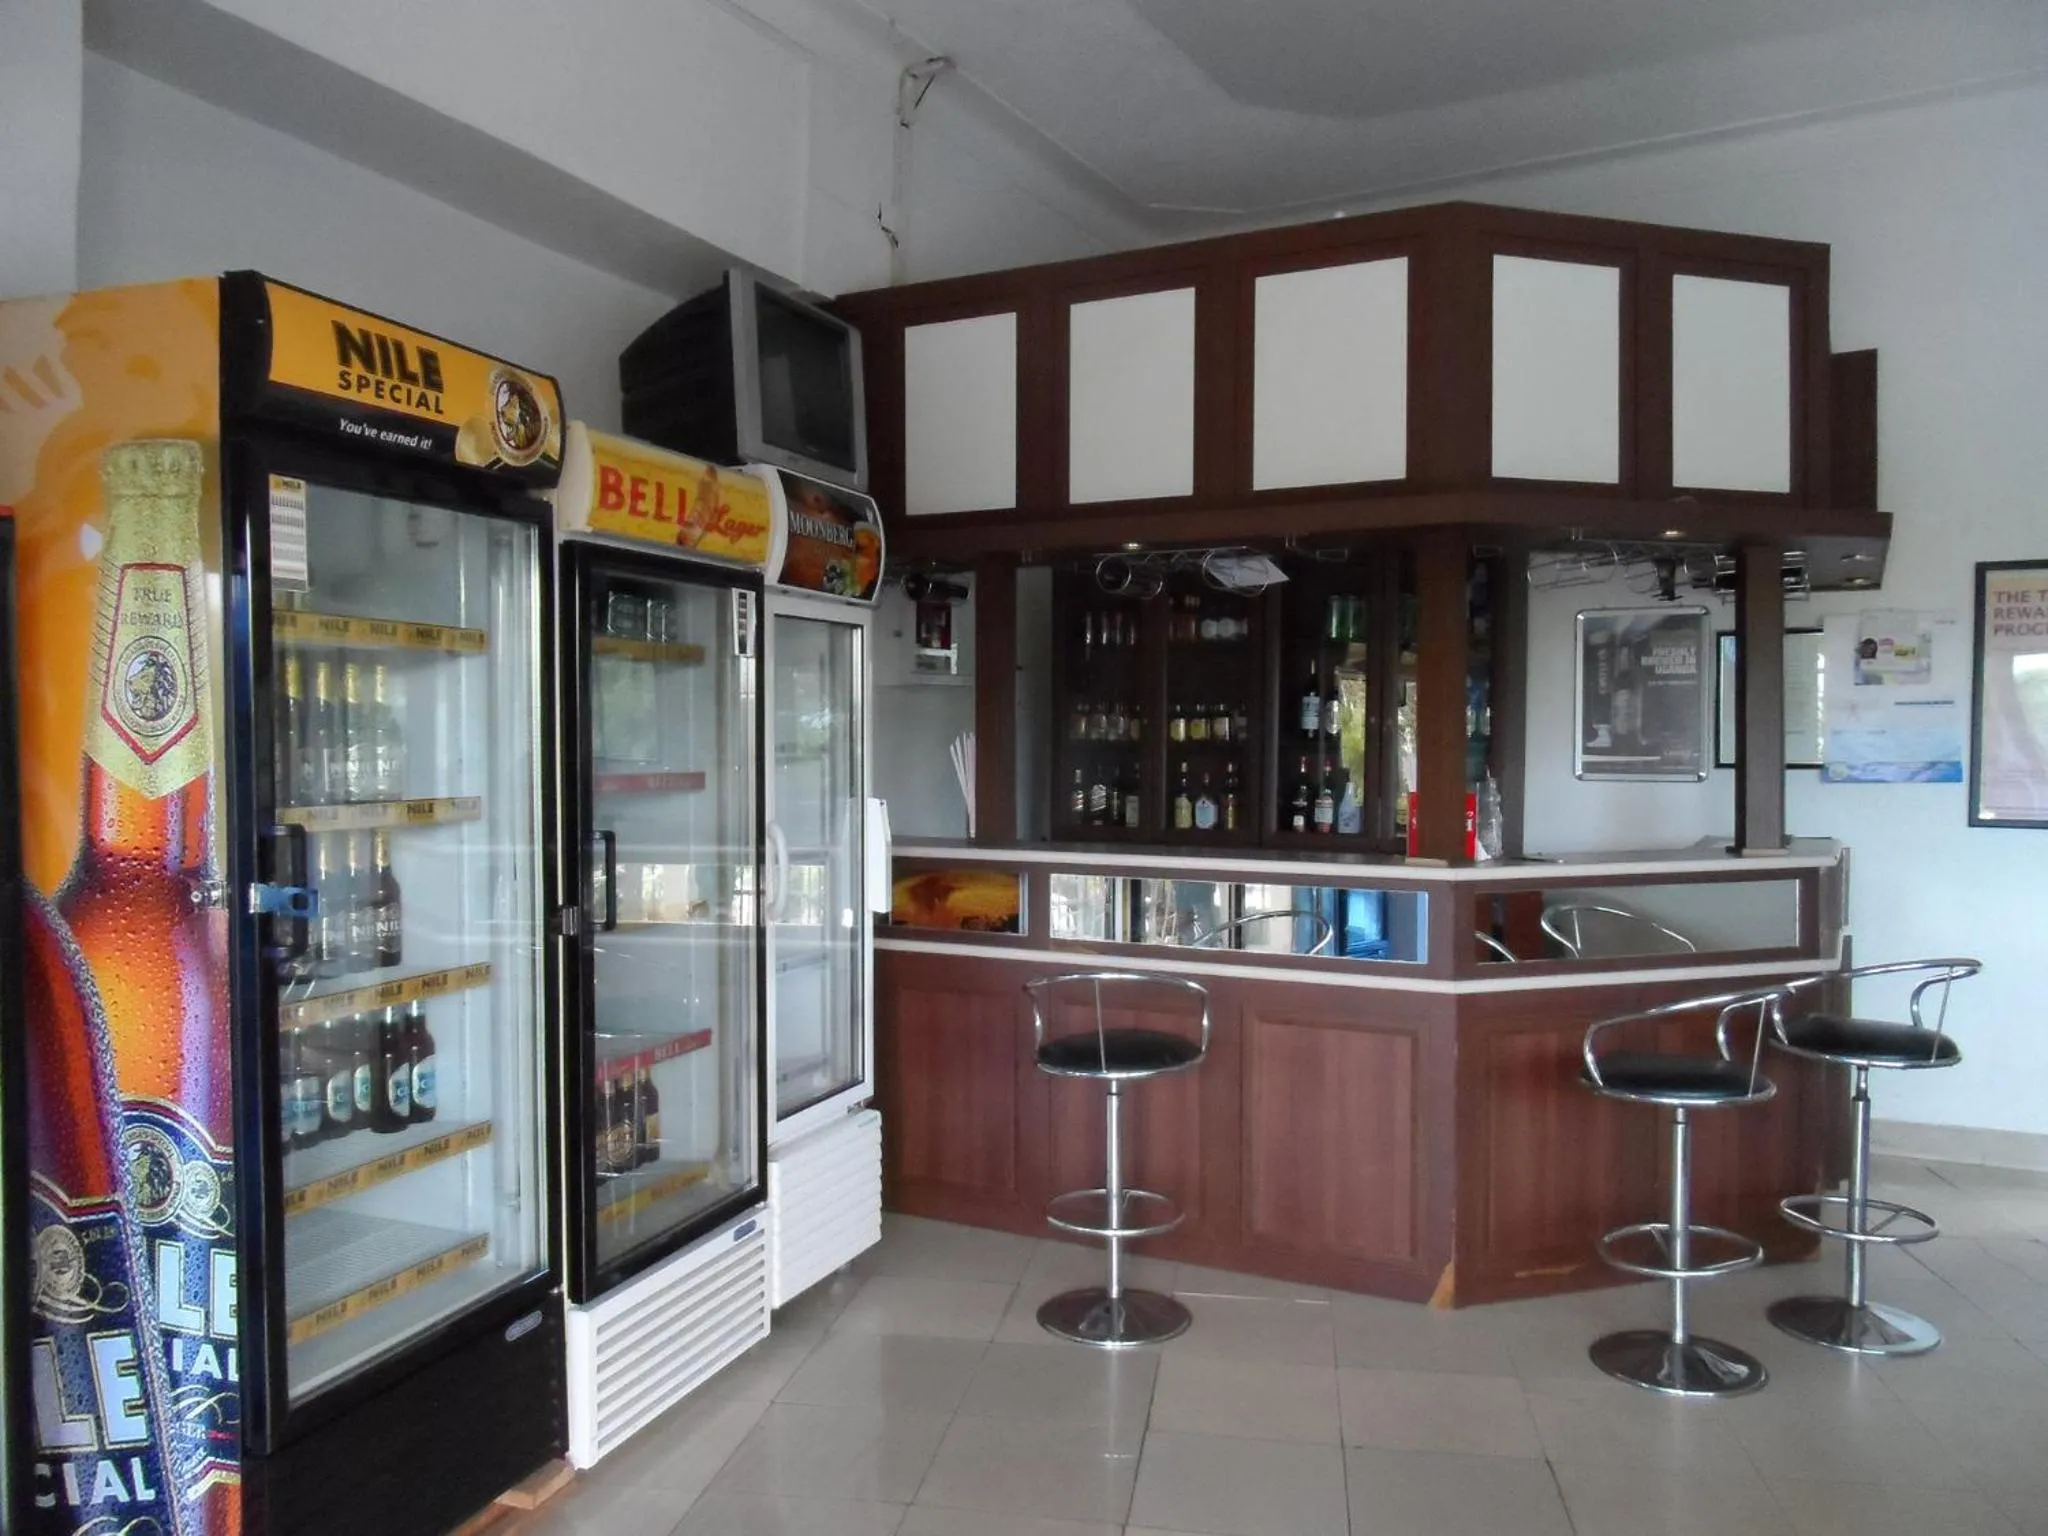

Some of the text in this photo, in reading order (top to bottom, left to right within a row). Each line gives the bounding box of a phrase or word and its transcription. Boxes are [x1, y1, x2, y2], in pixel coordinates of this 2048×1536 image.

[331, 319, 444, 393] NILE
[338, 370, 444, 415] SPECIAL
[339, 417, 432, 450] You've earned it!
[599, 464, 766, 544] BELL Lager
[134, 586, 172, 603] TRUE
[1992, 590, 2031, 604] THE
[121, 612, 183, 629] REWARD
[1993, 622, 2048, 637] PROC
[376, 921, 402, 932] NIL
